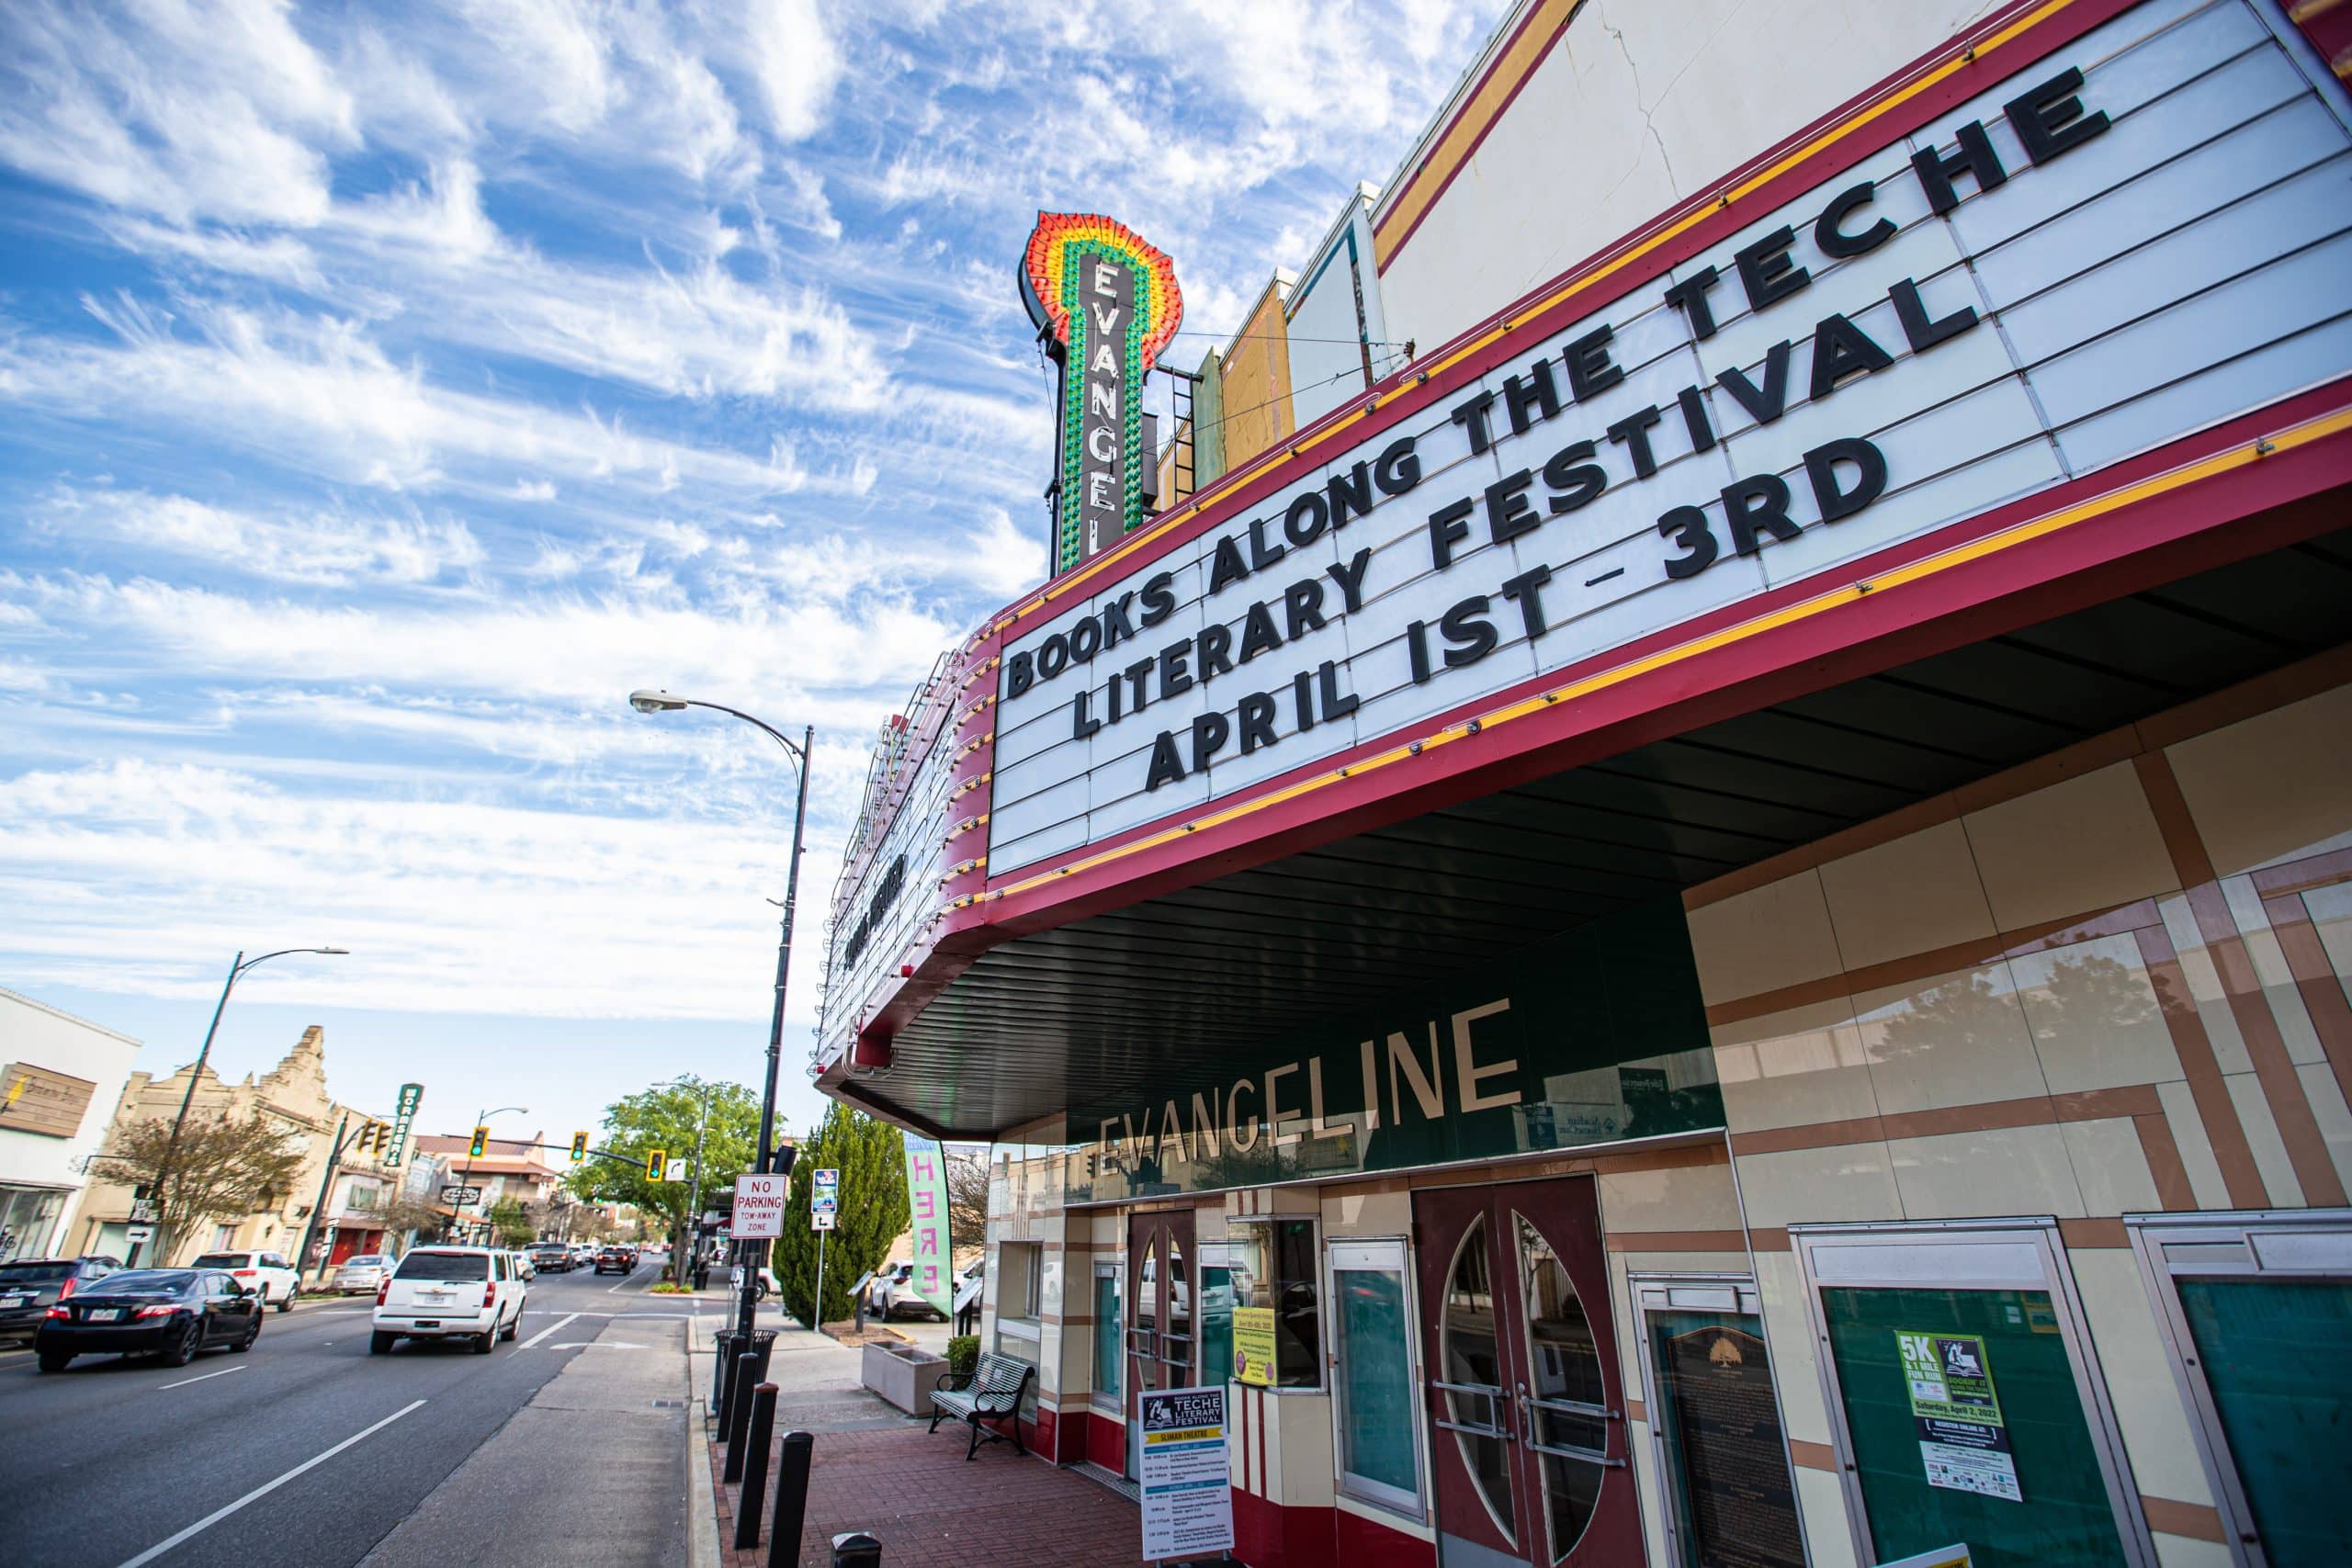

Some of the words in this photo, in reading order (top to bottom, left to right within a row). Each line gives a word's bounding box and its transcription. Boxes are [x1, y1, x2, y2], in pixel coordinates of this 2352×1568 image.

[1007, 571, 1175, 700] BOOKS
[1209, 436, 1421, 595] ALONG
[1451, 323, 1624, 456] THE
[1665, 65, 2111, 341] TECHE
[1074, 547, 1372, 740] LITERARY
[1429, 277, 1980, 570] FESTIVAL
[1145, 660, 1360, 793] APRIL
[1657, 436, 1887, 580] 3RD
[1099, 998, 1522, 1177] EVANGELINE
[751, 1181, 771, 1192] NO
[738, 1197, 782, 1208] PARKING
[741, 1212, 776, 1220] TOW-AWAY
[748, 1223, 766, 1231] ZONE
[1900, 1336, 1937, 1362] 5K
[1919, 1362, 1940, 1371] MILE
[1906, 1370, 1925, 1379] FUN
[1925, 1371, 1942, 1382] RUN
[1174, 1397, 1220, 1411] TECHE
[1916, 1401, 1949, 1413] Saturday,
[1951, 1405, 1968, 1414] April
[1969, 1407, 1977, 1416] 2,
[1977, 1408, 1996, 1417] 2022
[1175, 1408, 1220, 1419] LITERARY
[1175, 1416, 1220, 1426] FESTIVAL
